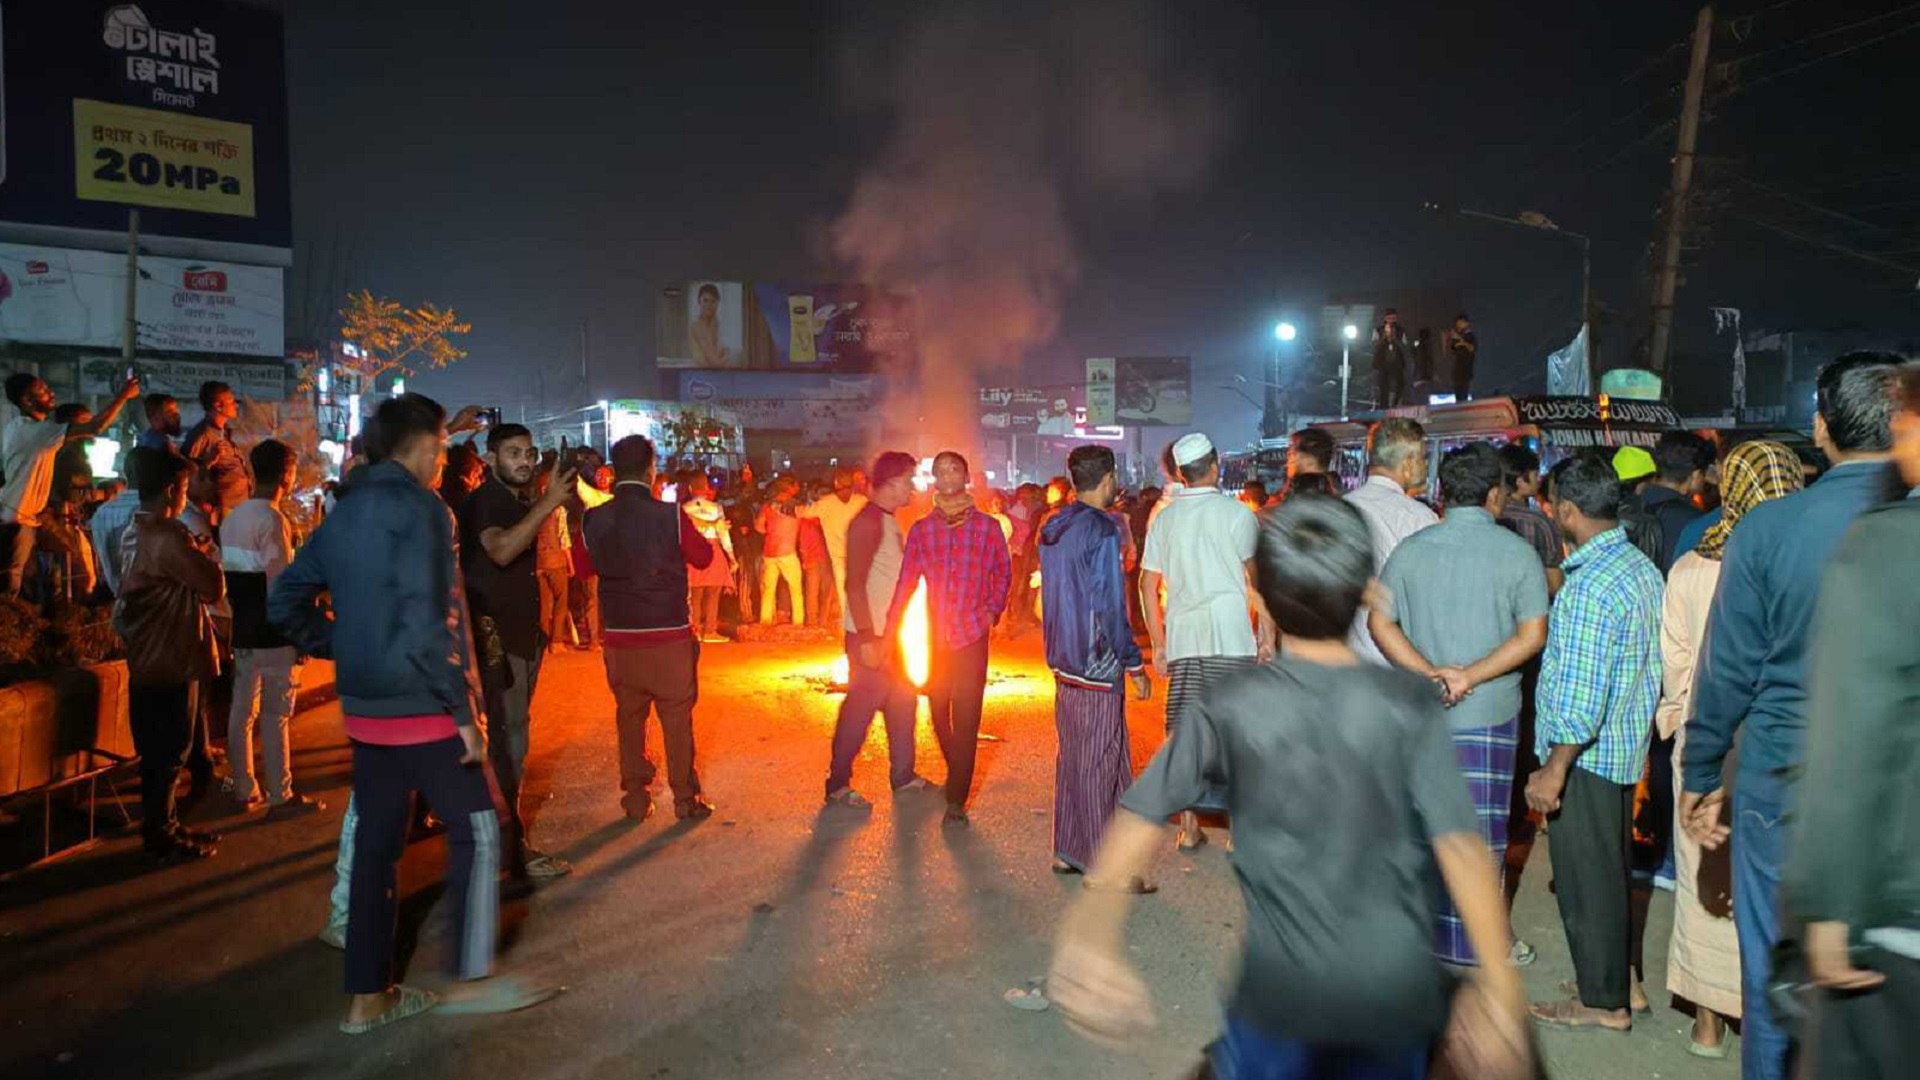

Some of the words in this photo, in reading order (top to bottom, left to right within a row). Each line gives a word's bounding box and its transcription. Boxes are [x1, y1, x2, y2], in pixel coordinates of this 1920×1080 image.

[125, 25, 221, 69] ঢালাই
[153, 130, 199, 153] দিনের
[979, 387, 1013, 407] Lily
